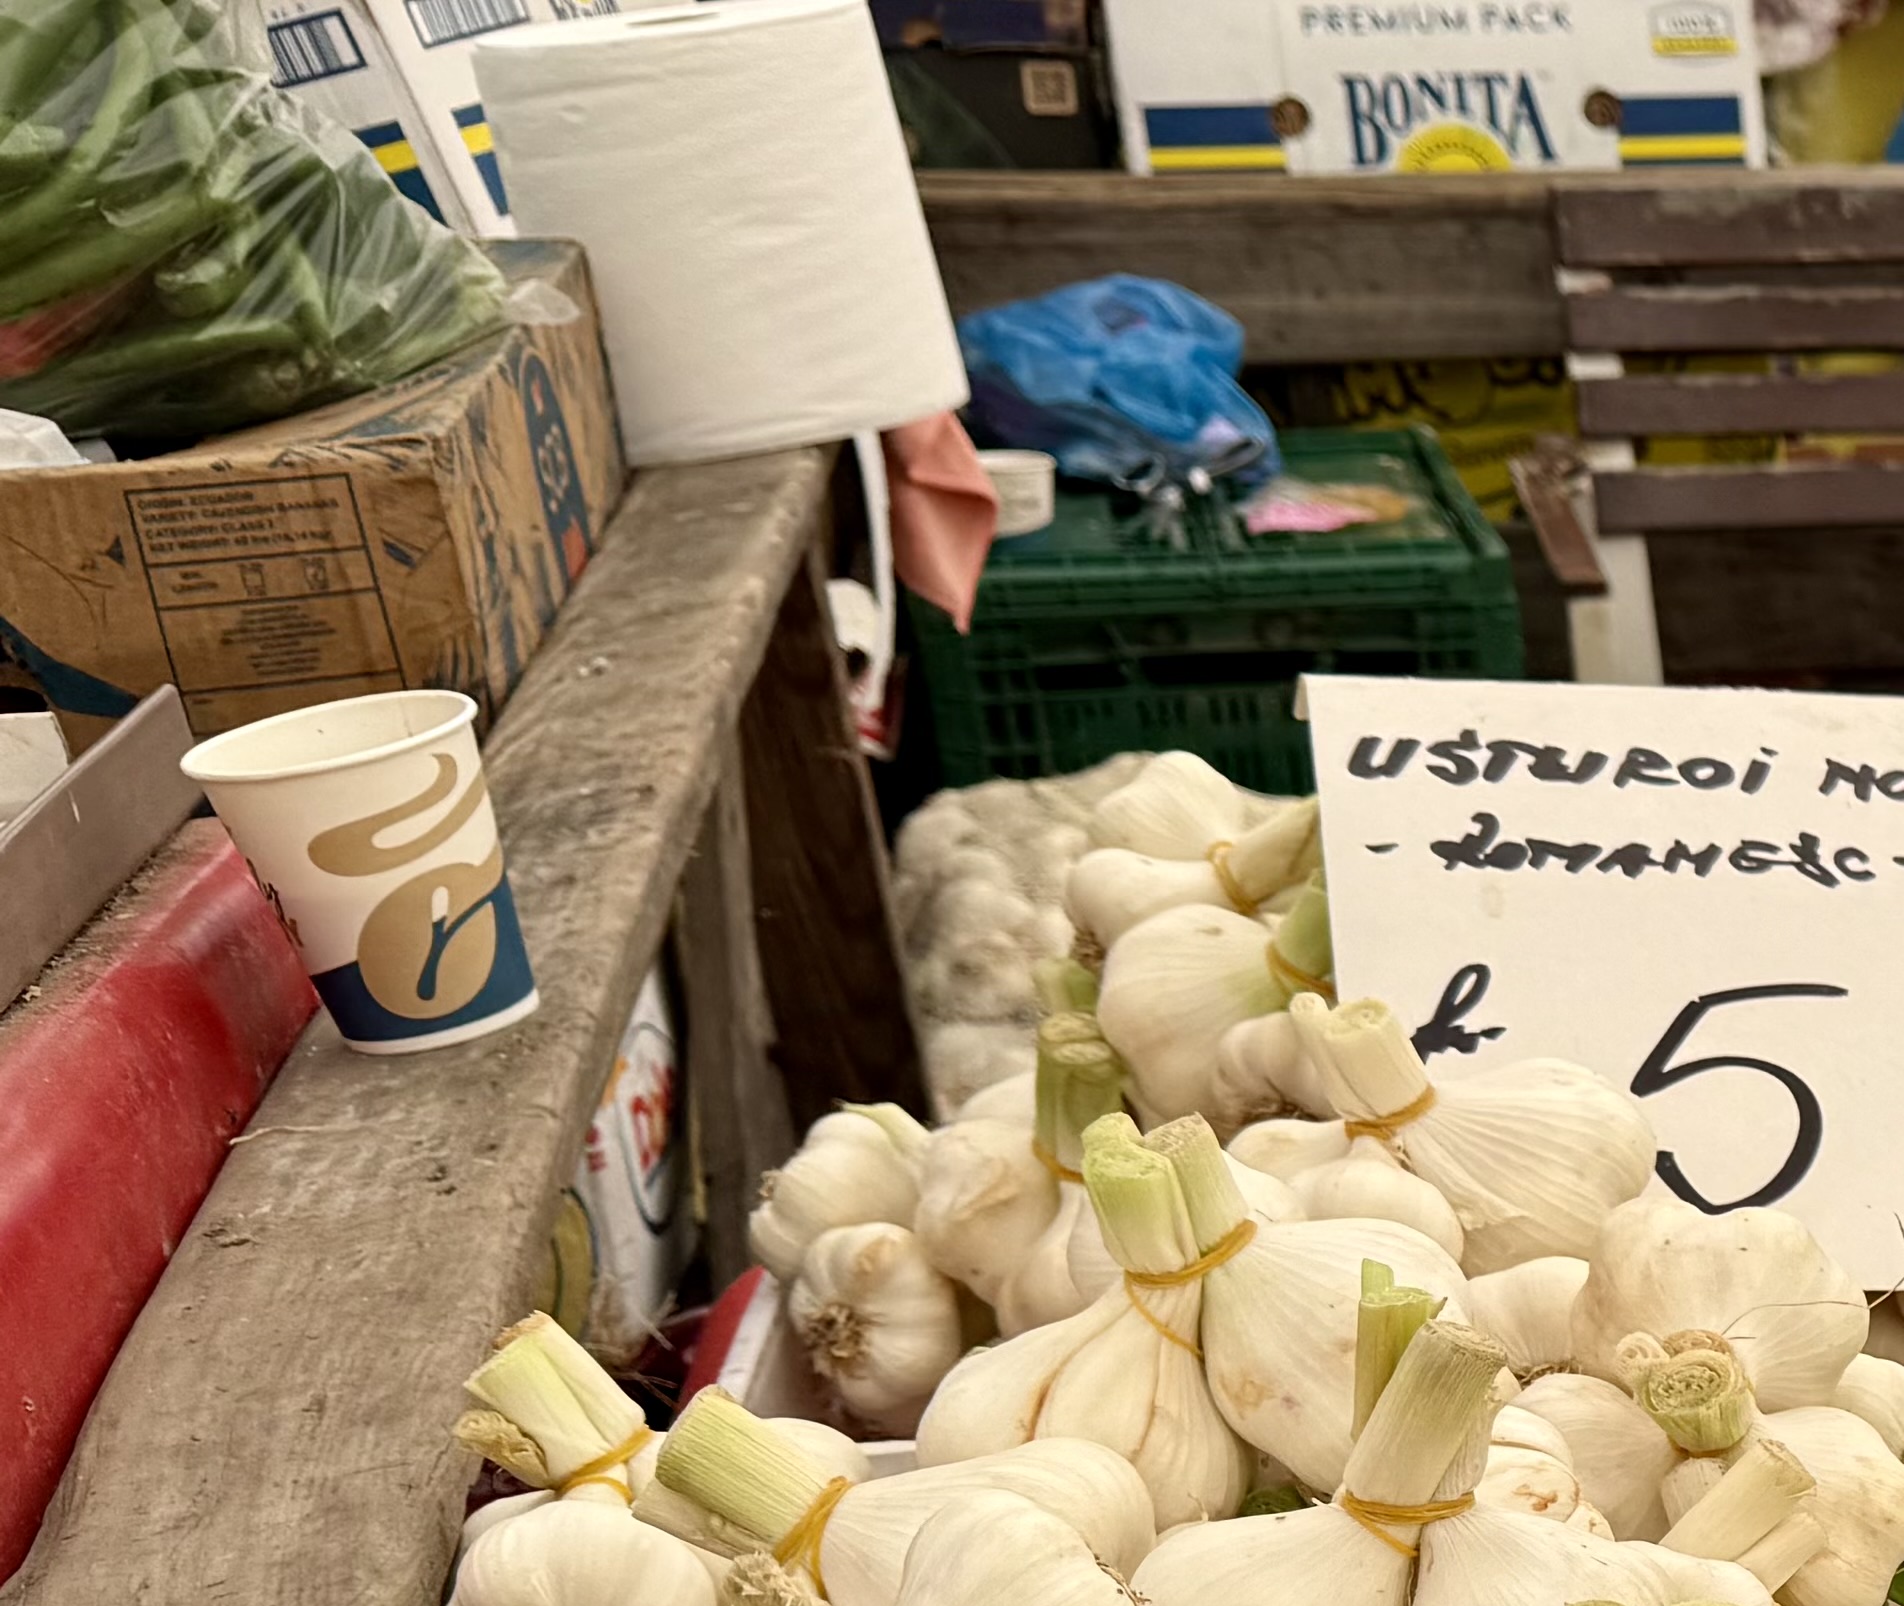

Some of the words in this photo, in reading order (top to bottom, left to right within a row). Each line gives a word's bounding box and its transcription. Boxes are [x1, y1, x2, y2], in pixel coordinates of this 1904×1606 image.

[1300, 5, 1470, 36] PREMIUM
[1481, 3, 1574, 34] PACK
[1340, 70, 1561, 167] BONITA
[1630, 983, 1849, 1216] 5
